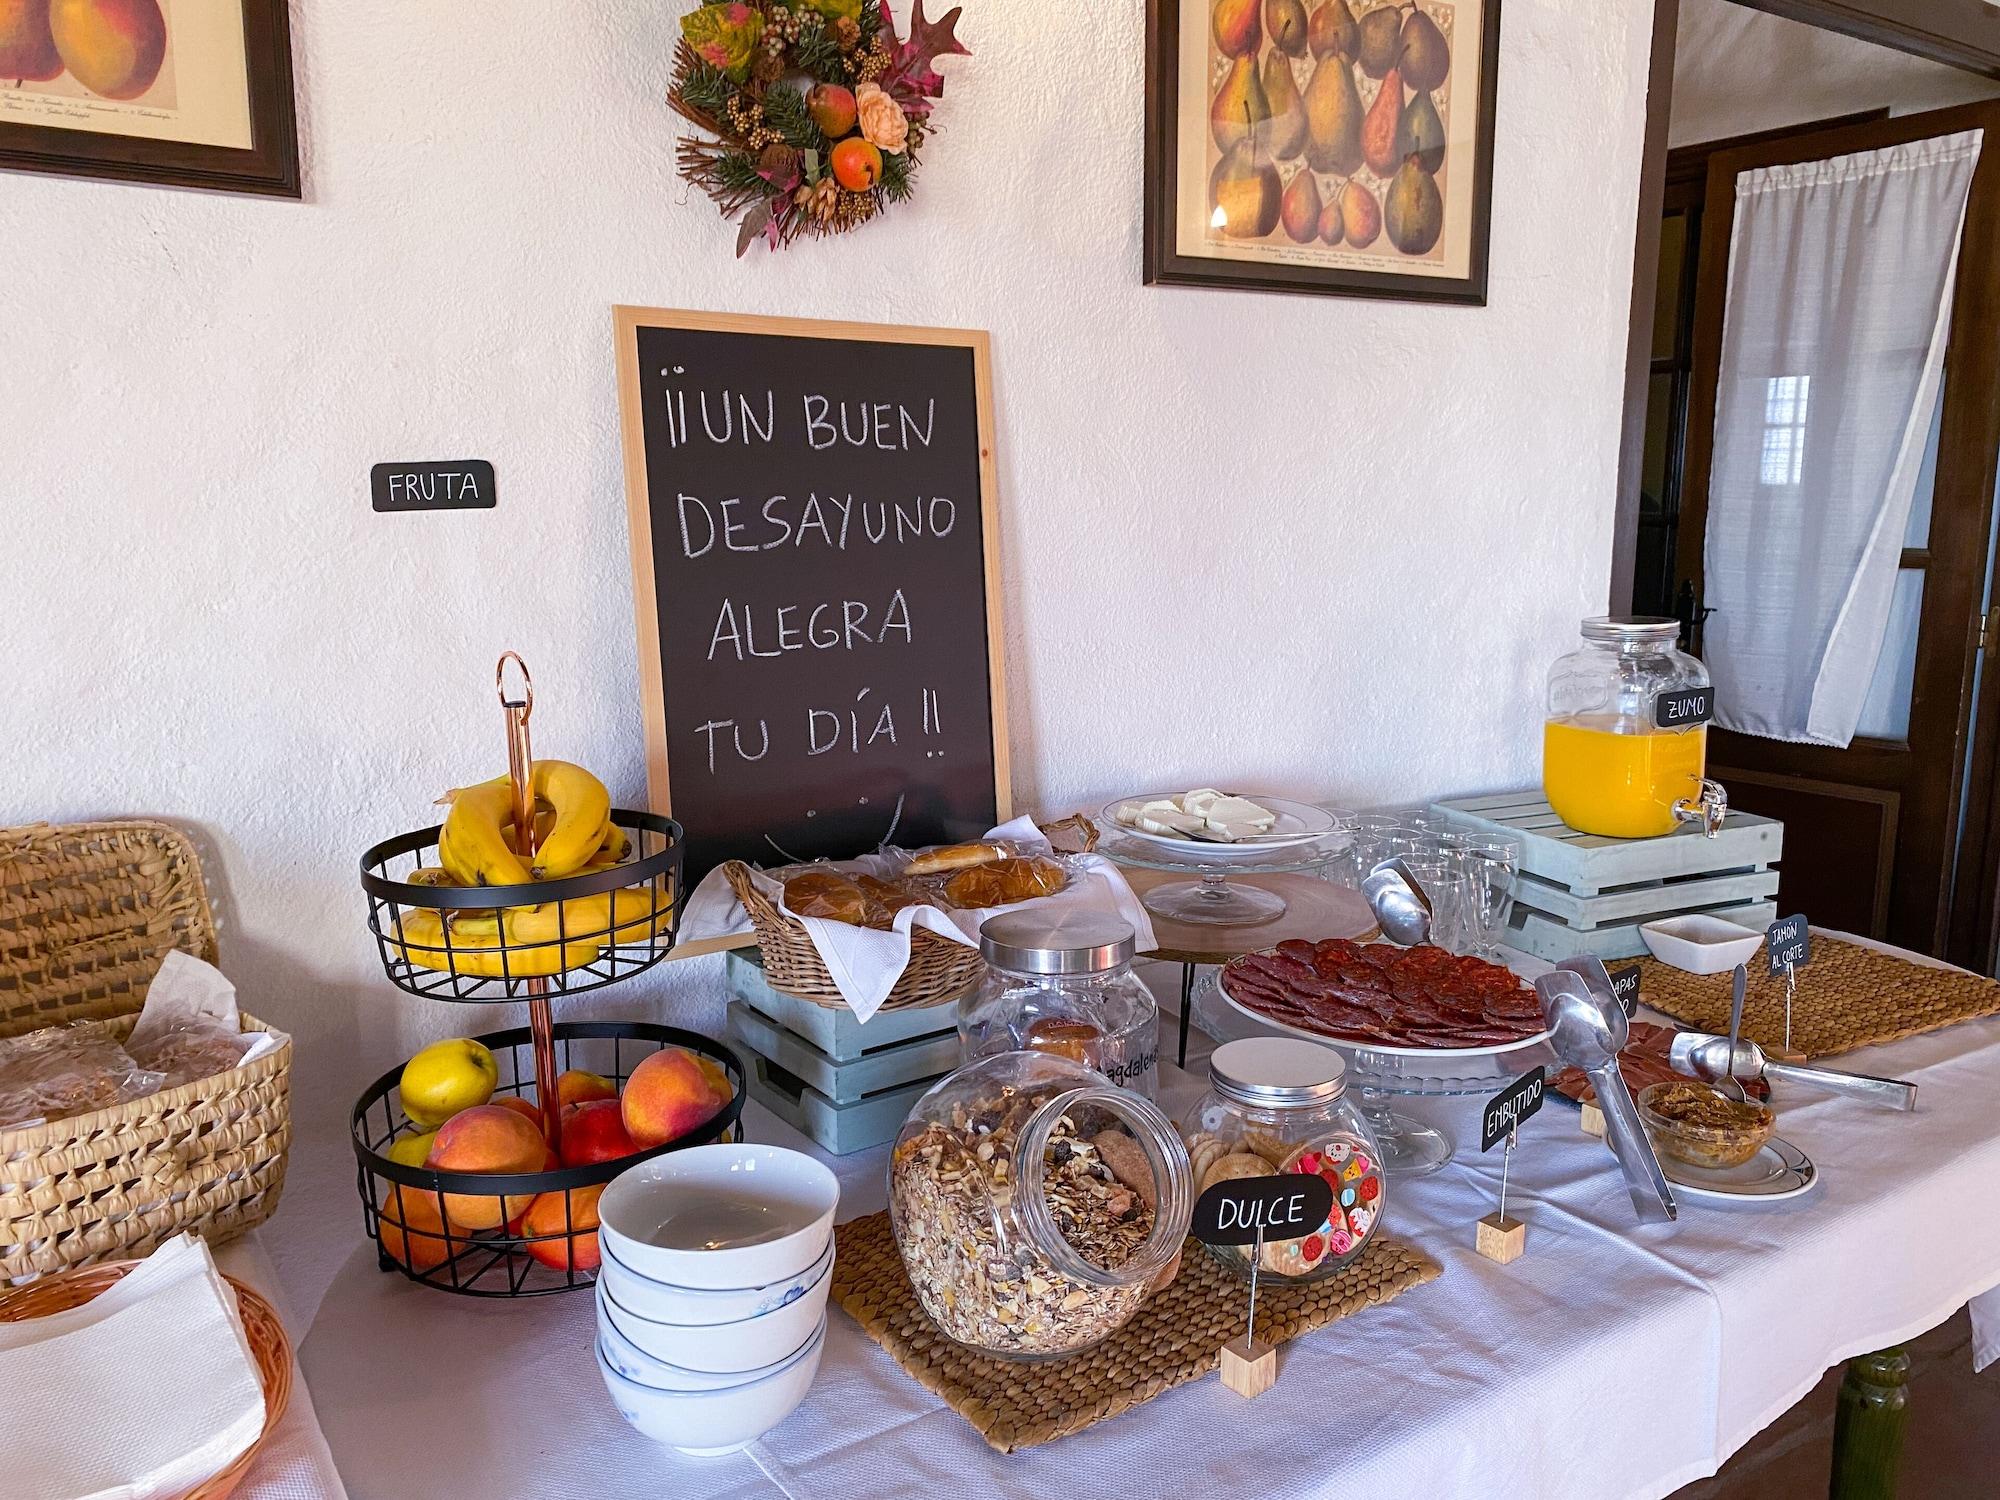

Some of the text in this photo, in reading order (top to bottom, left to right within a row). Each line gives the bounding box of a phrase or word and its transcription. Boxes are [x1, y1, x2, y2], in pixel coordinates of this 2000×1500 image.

[803, 394, 936, 451] BUEN
[388, 472, 479, 502] FRUTA
[677, 492, 957, 558] DESAYUNO
[708, 588, 913, 661] ALEGRA
[1668, 696, 1704, 718] ZUMO
[694, 718, 770, 775] TU
[806, 687, 898, 755] DÍA
[1771, 943, 1804, 970] AL CORTE
[1614, 974, 1637, 995] APAS
[1487, 1079, 1542, 1138] EMBUTIDO
[1217, 1193, 1306, 1230] DULCE
